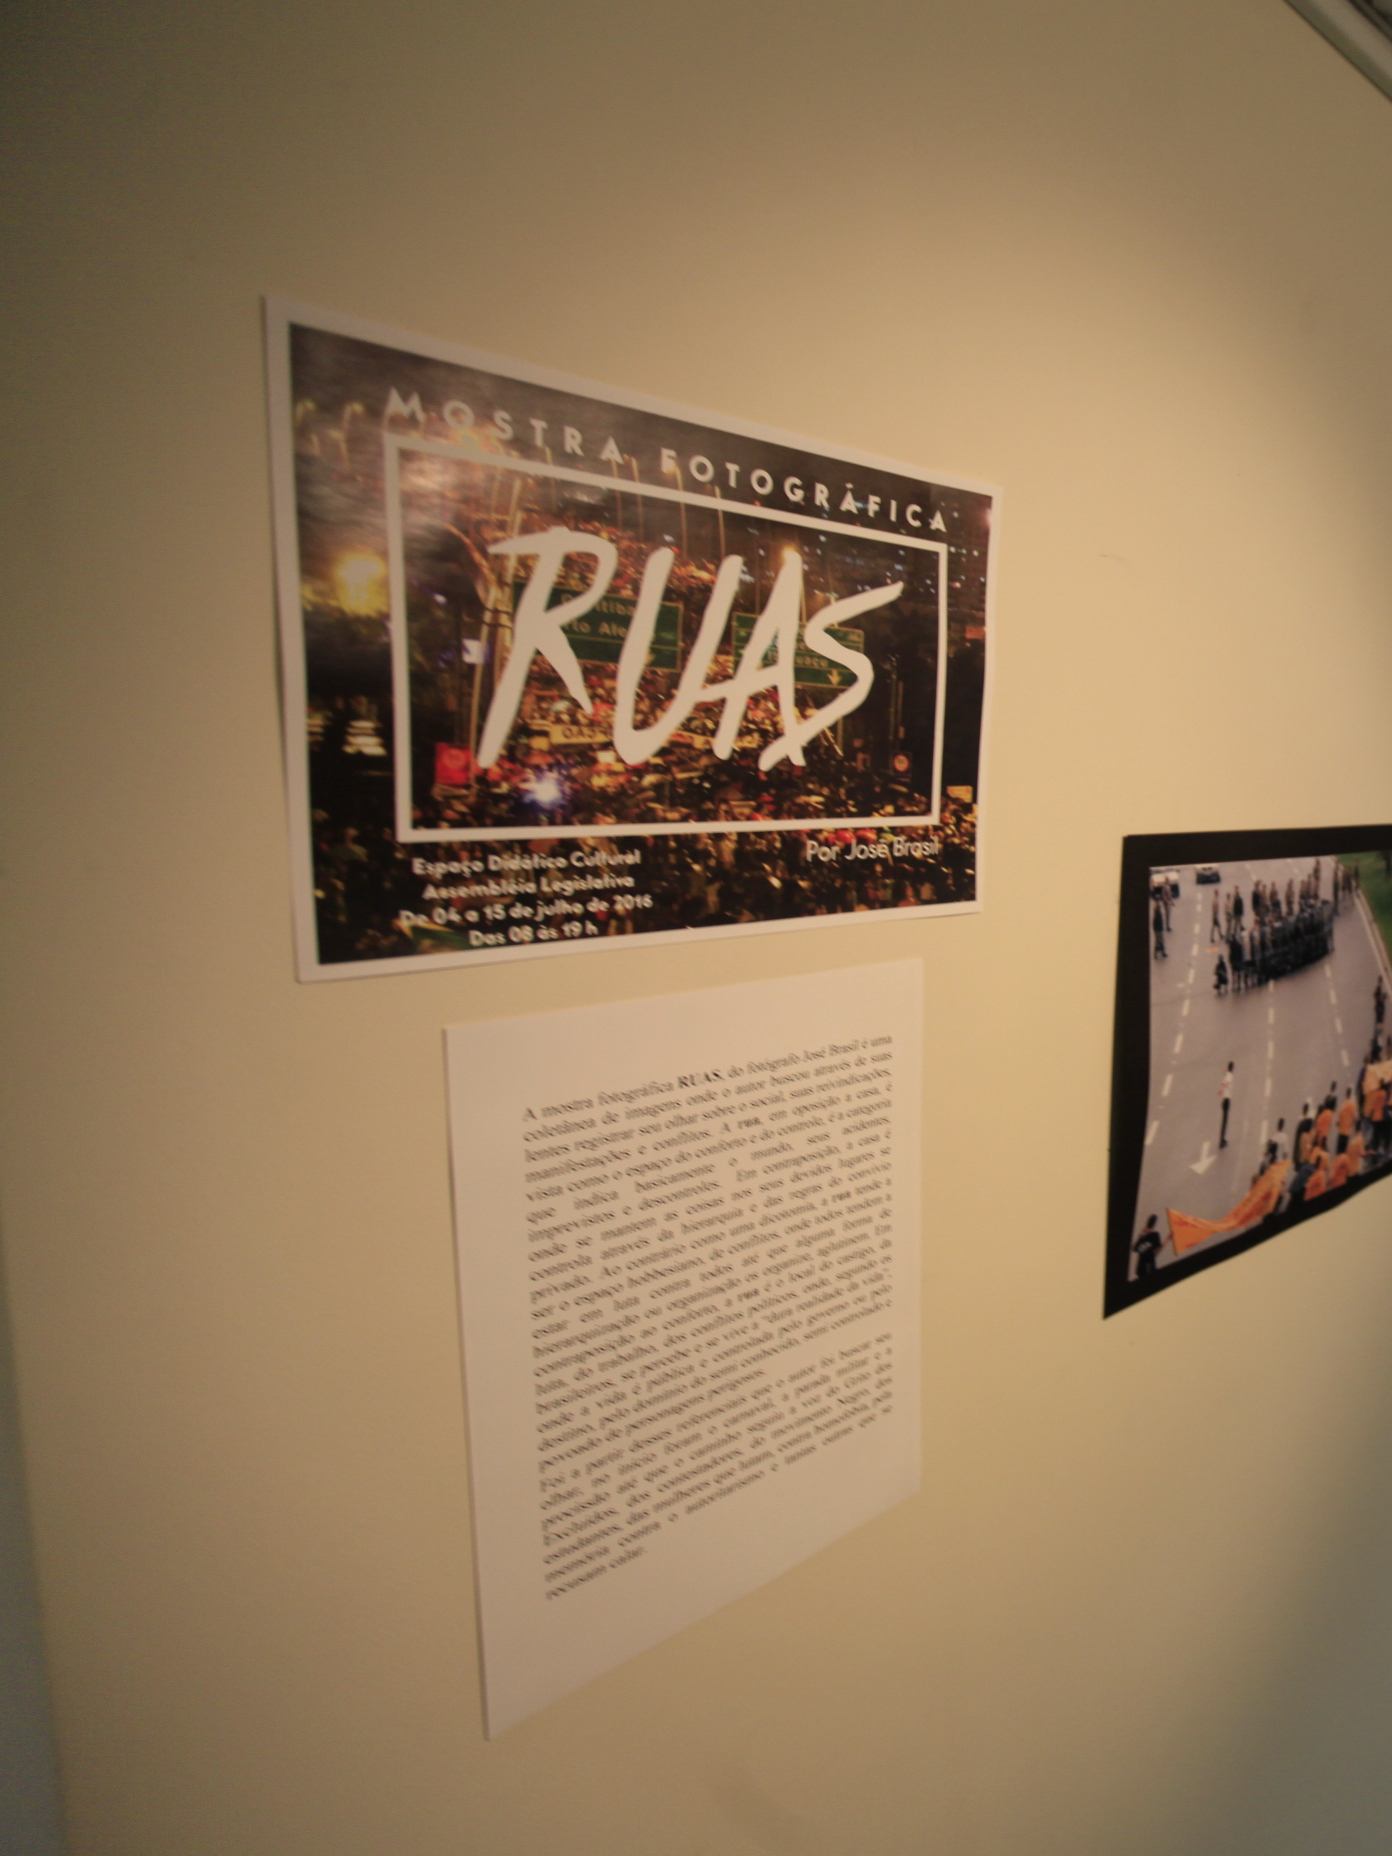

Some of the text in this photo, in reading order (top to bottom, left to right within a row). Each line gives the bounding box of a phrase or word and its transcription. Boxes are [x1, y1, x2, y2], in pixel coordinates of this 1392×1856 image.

[384, 387, 948, 532] MOSTRA FOTOGRÁFICA
[476, 526, 905, 772] RUAS
[411, 849, 642, 879] Espaço Didático Cultural
[806, 834, 939, 862] Por José Brasil
[399, 893, 654, 926] De 04 a 15 de julho de 2016
[421, 873, 635, 901] Assembléia Legislativa
[468, 929, 506, 946] Das
[508, 925, 535, 943] 08
[561, 920, 583, 937] 19
[584, 920, 599, 935] h
[540, 1098, 594, 1118] mostra
[727, 1065, 744, 1078] do
[828, 1039, 859, 1056] Brasil
[869, 1035, 892, 1047] uma
[601, 1110, 619, 1125] de
[624, 1099, 682, 1120] imagens
[685, 1088, 718, 1106] onde
[734, 1080, 766, 1095] autor
[769, 1070, 810, 1087] buscou
[854, 1055, 867, 1067] de
[870, 1051, 892, 1063] suas
[524, 1143, 571, 1163] lentes
[573, 1128, 635, 1151] registrar
[637, 1122, 662, 1136] seu
[664, 1113, 699, 1129] olhar
[701, 1104, 736, 1121] sobre
[789, 1086, 814, 1099] suas
[525, 1185, 563, 1202] vista
[566, 1173, 609, 1192] como
[674, 1150, 692, 1164] do
[694, 1137, 747, 1158] conforto
[758, 1128, 775, 1141] do
[845, 1099, 892, 1121] categoria
[768, 1109, 787, 1121] em
[525, 1206, 556, 1225] que
[573, 1190, 619, 1210] indica
[806, 1131, 830, 1145] seus
[736, 1168, 757, 1182] Em
[857, 1133, 880, 1146] casa
[527, 1239, 567, 1262] onde
[575, 1235, 592, 1249] se
[663, 1210, 679, 1222] as
[685, 1196, 724, 1215] coisas
[730, 1187, 752, 1201] nos
[758, 1178, 784, 1192] seus
[789, 1163, 832, 1183] devidos
[838, 1151, 875, 1169] lugares
[879, 1146, 891, 1156] se
[528, 1253, 592, 1282] controla
[656, 1228, 674, 1242] da
[763, 1195, 783, 1208] das
[788, 1183, 823, 1200] regras
[827, 1175, 842, 1188] do
